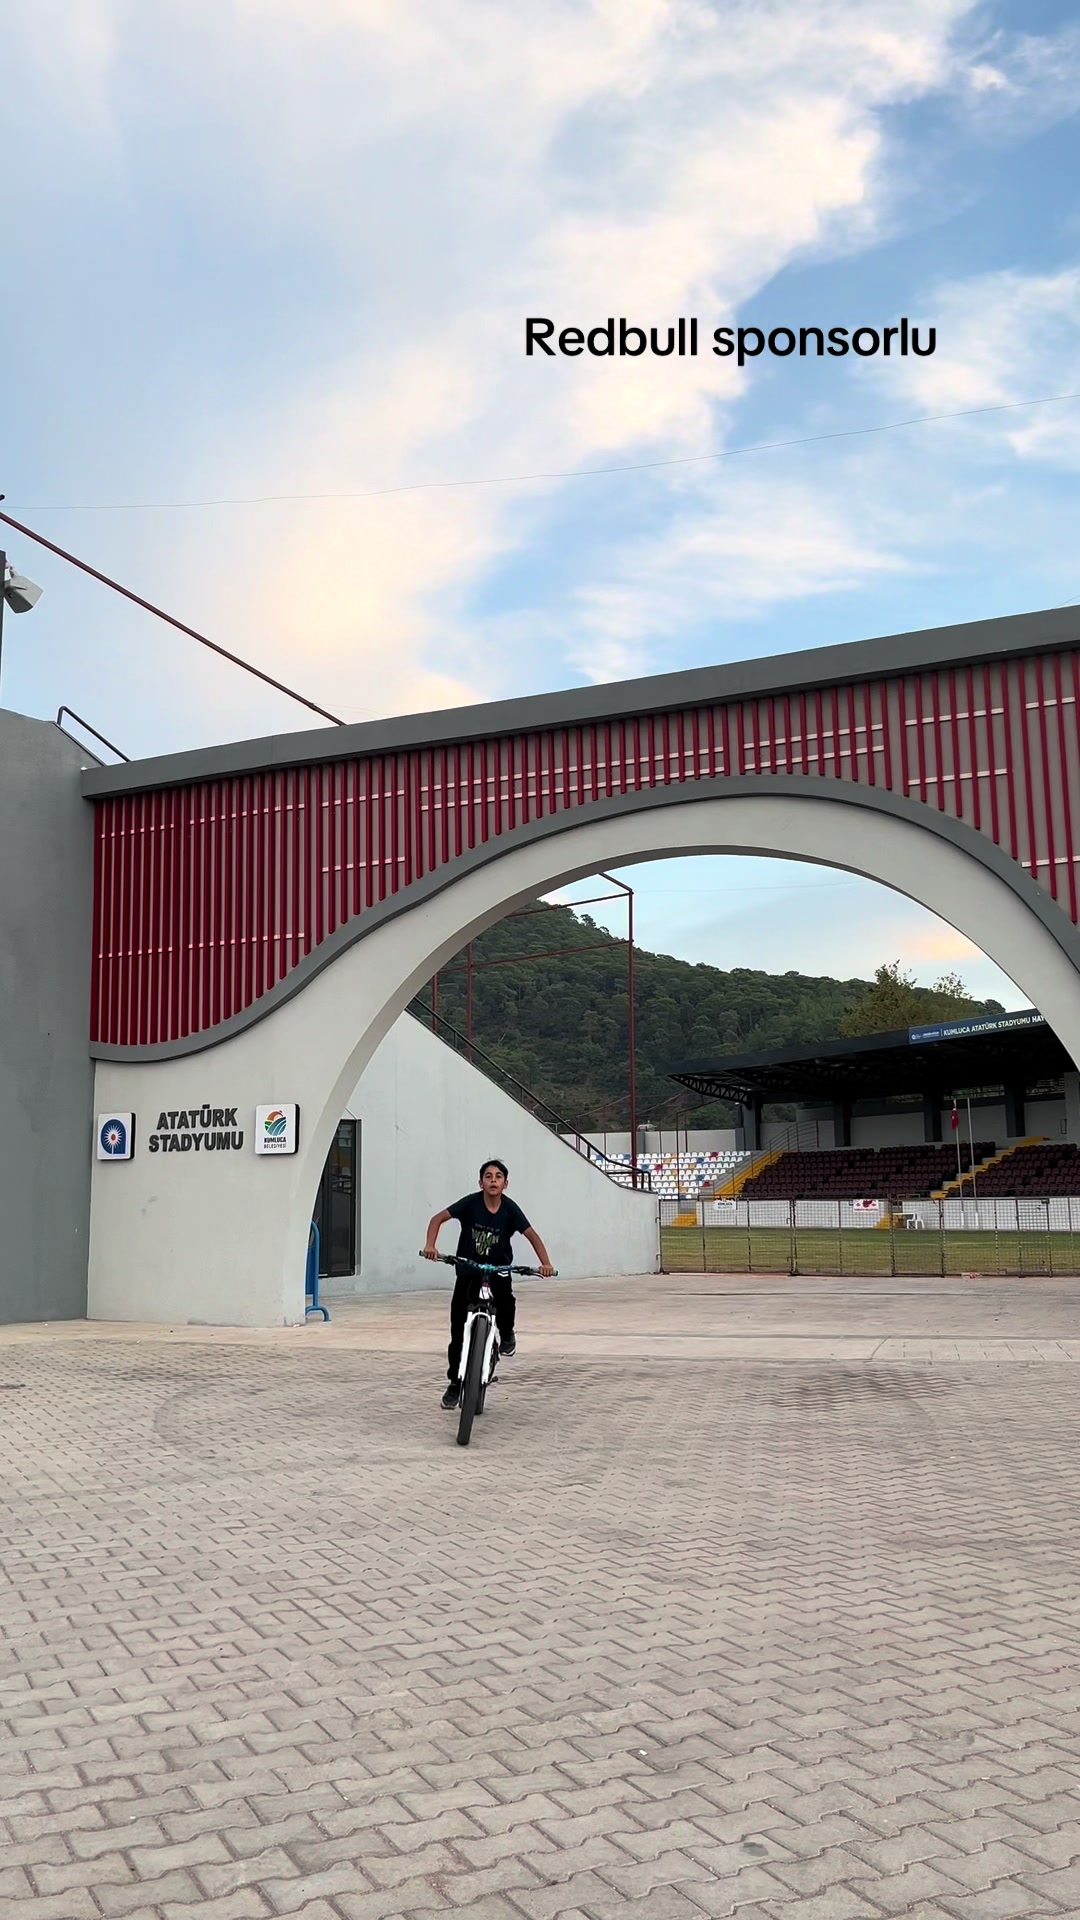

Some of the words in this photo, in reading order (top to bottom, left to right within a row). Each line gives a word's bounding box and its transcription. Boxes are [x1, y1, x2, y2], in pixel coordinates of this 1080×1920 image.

[943, 1027, 971, 1036] KUMLUCA
[971, 1021, 997, 1032] ATATÜRK
[998, 1017, 1031, 1028] STADYUMU
[156, 1104, 238, 1130] ATATÜRK
[148, 1131, 244, 1152] STADYUMU
